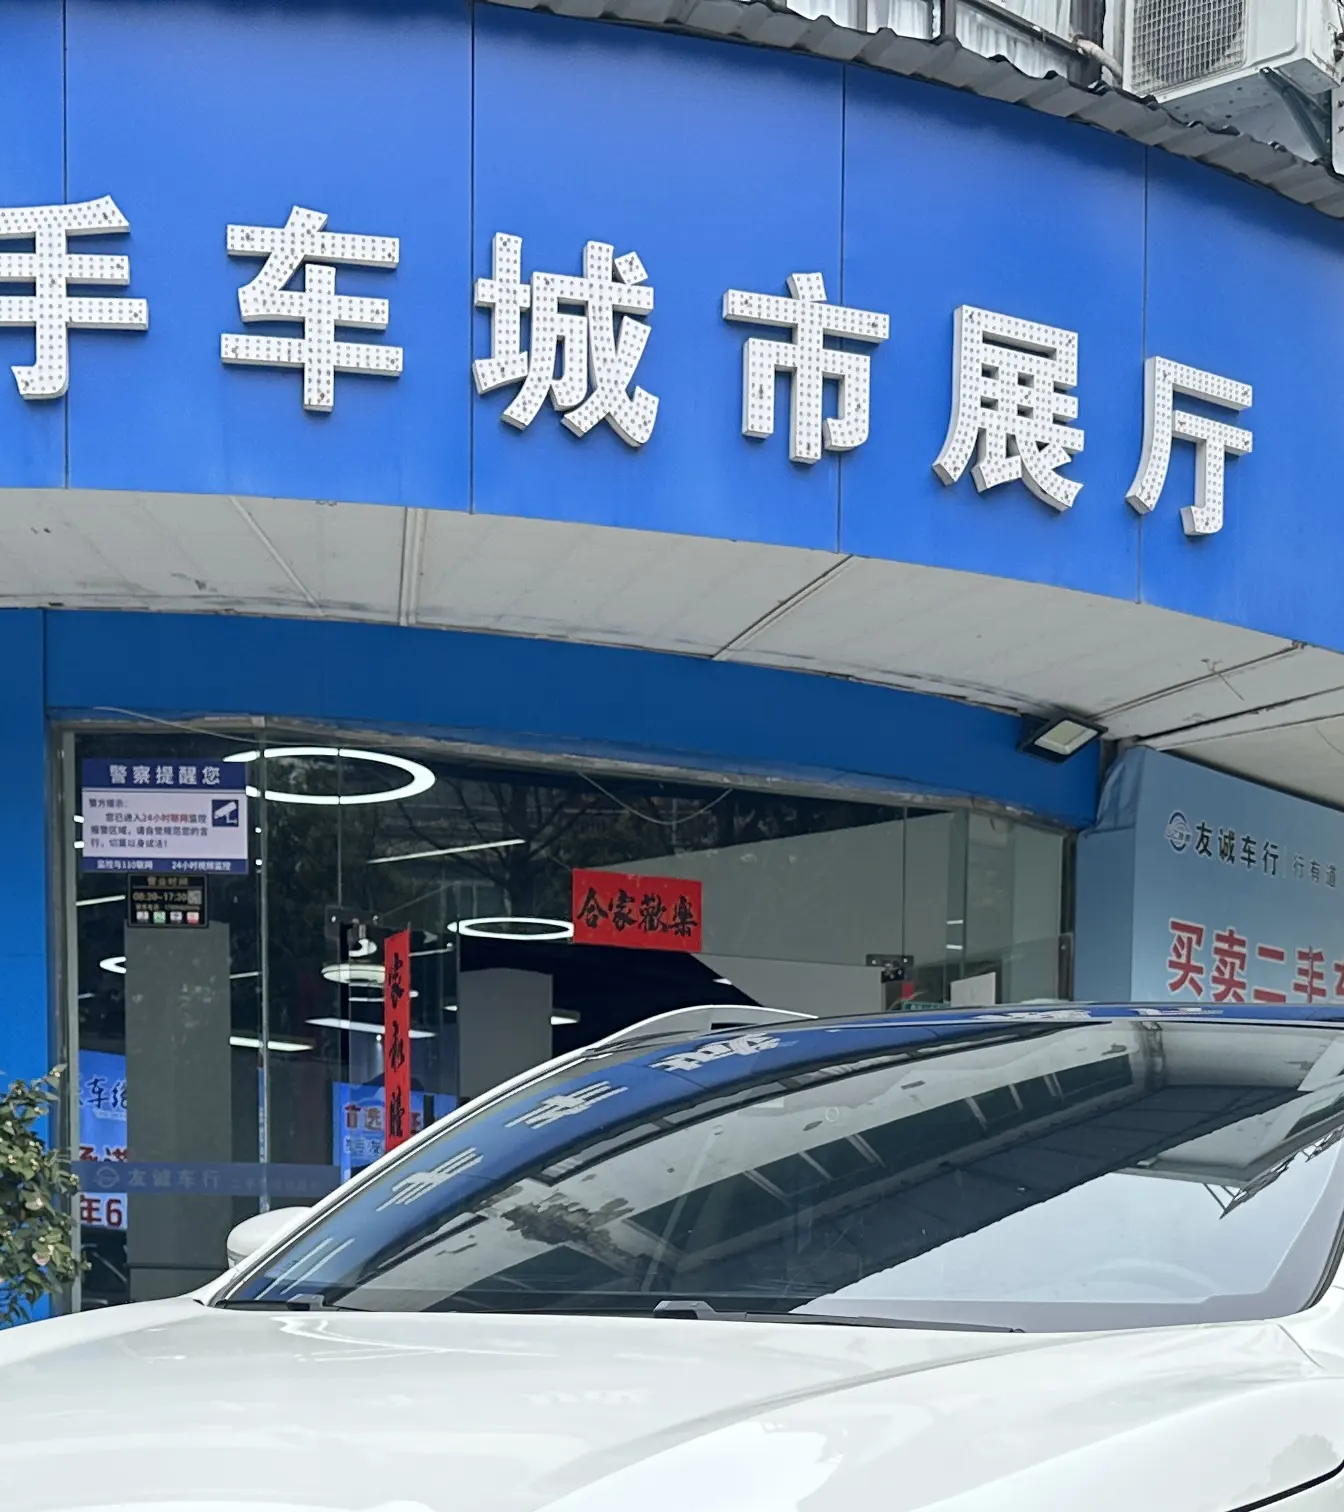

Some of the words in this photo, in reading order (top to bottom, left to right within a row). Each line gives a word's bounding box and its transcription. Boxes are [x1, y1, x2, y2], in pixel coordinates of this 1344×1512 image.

[109, 765, 220, 785] 警察提醒您
[1195, 822, 1279, 875] 友诚车行
